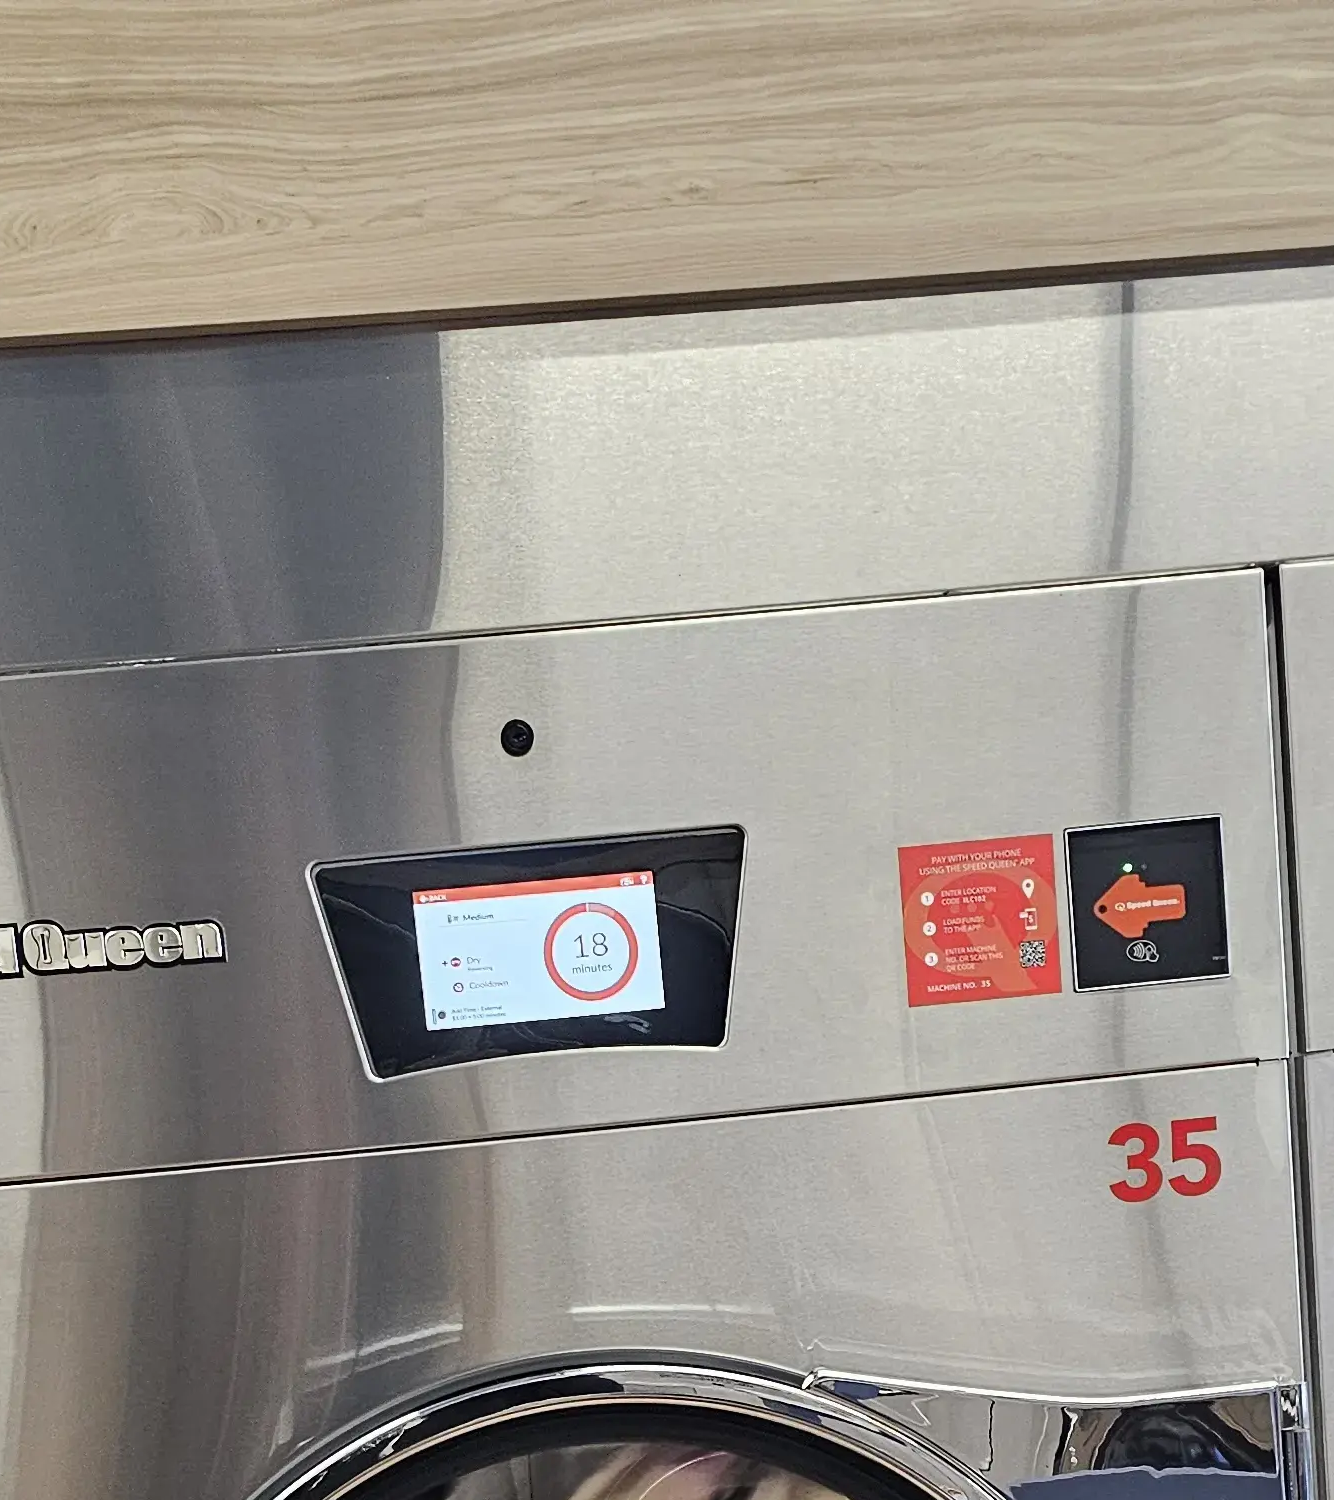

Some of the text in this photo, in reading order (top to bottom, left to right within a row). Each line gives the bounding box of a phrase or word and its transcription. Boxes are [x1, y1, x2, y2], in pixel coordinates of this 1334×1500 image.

[931, 848, 1022, 864] PAY WITH YOUR PHONE
[918, 866, 944, 876] USING
[945, 864, 961, 873] THE
[962, 862, 987, 871] SPEED
[1019, 857, 1035, 866] APP
[941, 886, 997, 897] ENTER LOCATION
[941, 897, 959, 905] CODE
[943, 915, 985, 926] LOAD FUNDS
[943, 926, 953, 934] TO
[967, 923, 982, 931] APP
[22, 919, 228, 973] Queen
[574, 932, 609, 958] 18
[944, 944, 997, 956] ENTER MACHINE
[467, 956, 481, 965] Dry
[969, 953, 987, 961] SCAN
[572, 964, 613, 974] minutes
[957, 963, 975, 971] CODE
[927, 983, 962, 993] MACHINE
[980, 979, 991, 988] 35
[1108, 1116, 1222, 1203] 35
